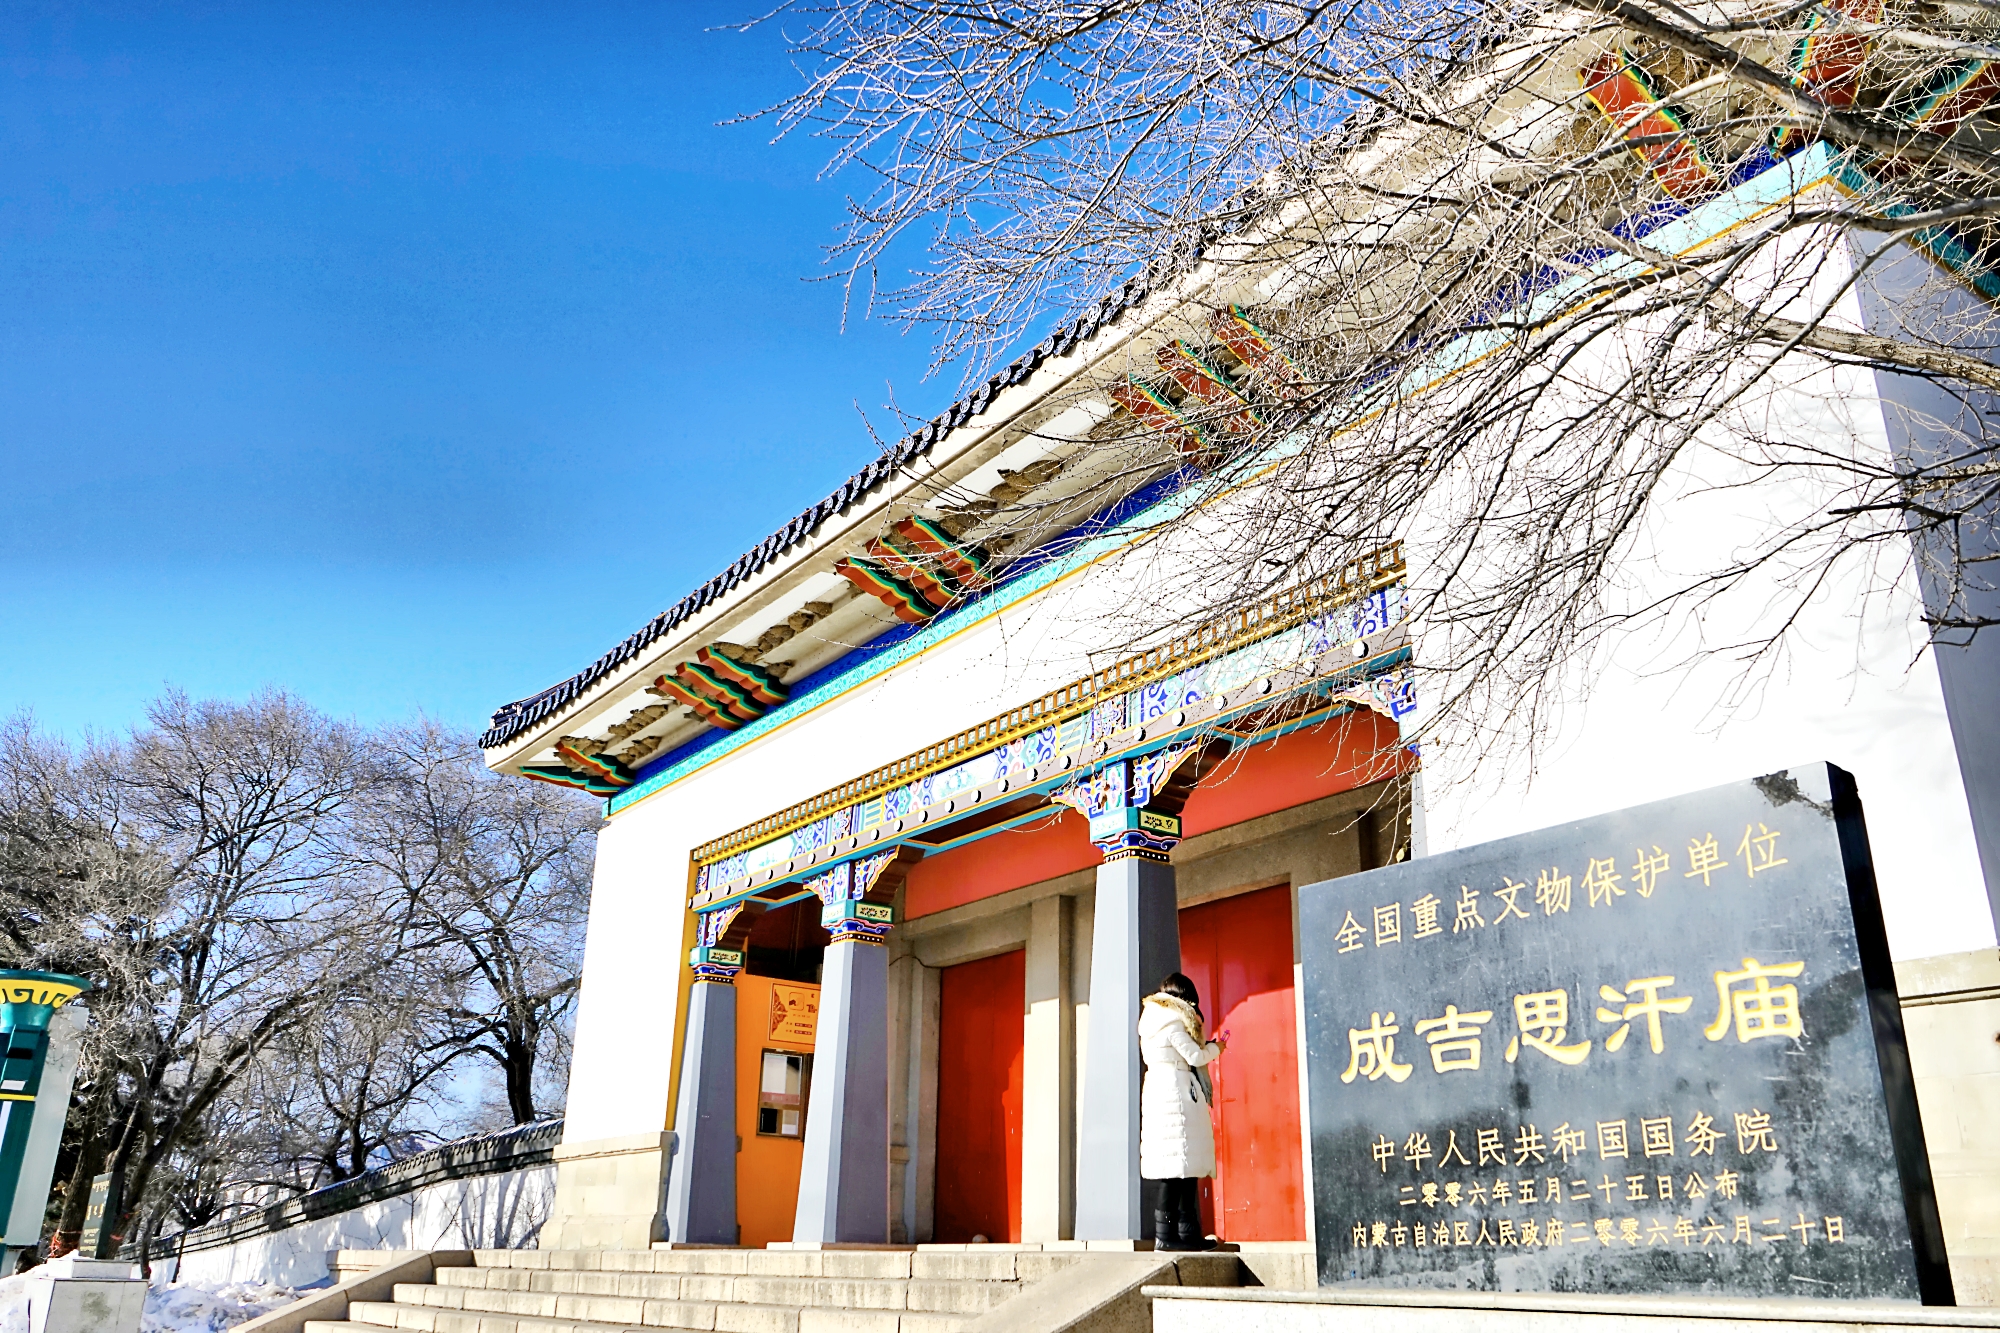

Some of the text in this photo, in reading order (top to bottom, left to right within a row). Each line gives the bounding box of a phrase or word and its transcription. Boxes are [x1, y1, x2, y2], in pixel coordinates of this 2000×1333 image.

[1334, 821, 1789, 954] 全国重点文物保护单位
[1341, 958, 1806, 1084] 成吉思汗庙
[1372, 1108, 1778, 1173] 中华人民共和国国务院
[1399, 1168, 1739, 1208] 二零零六年五月二十五日公布
[1352, 1213, 1845, 1248] 内蒙古自治区人民政府二零零六年六月二十日
